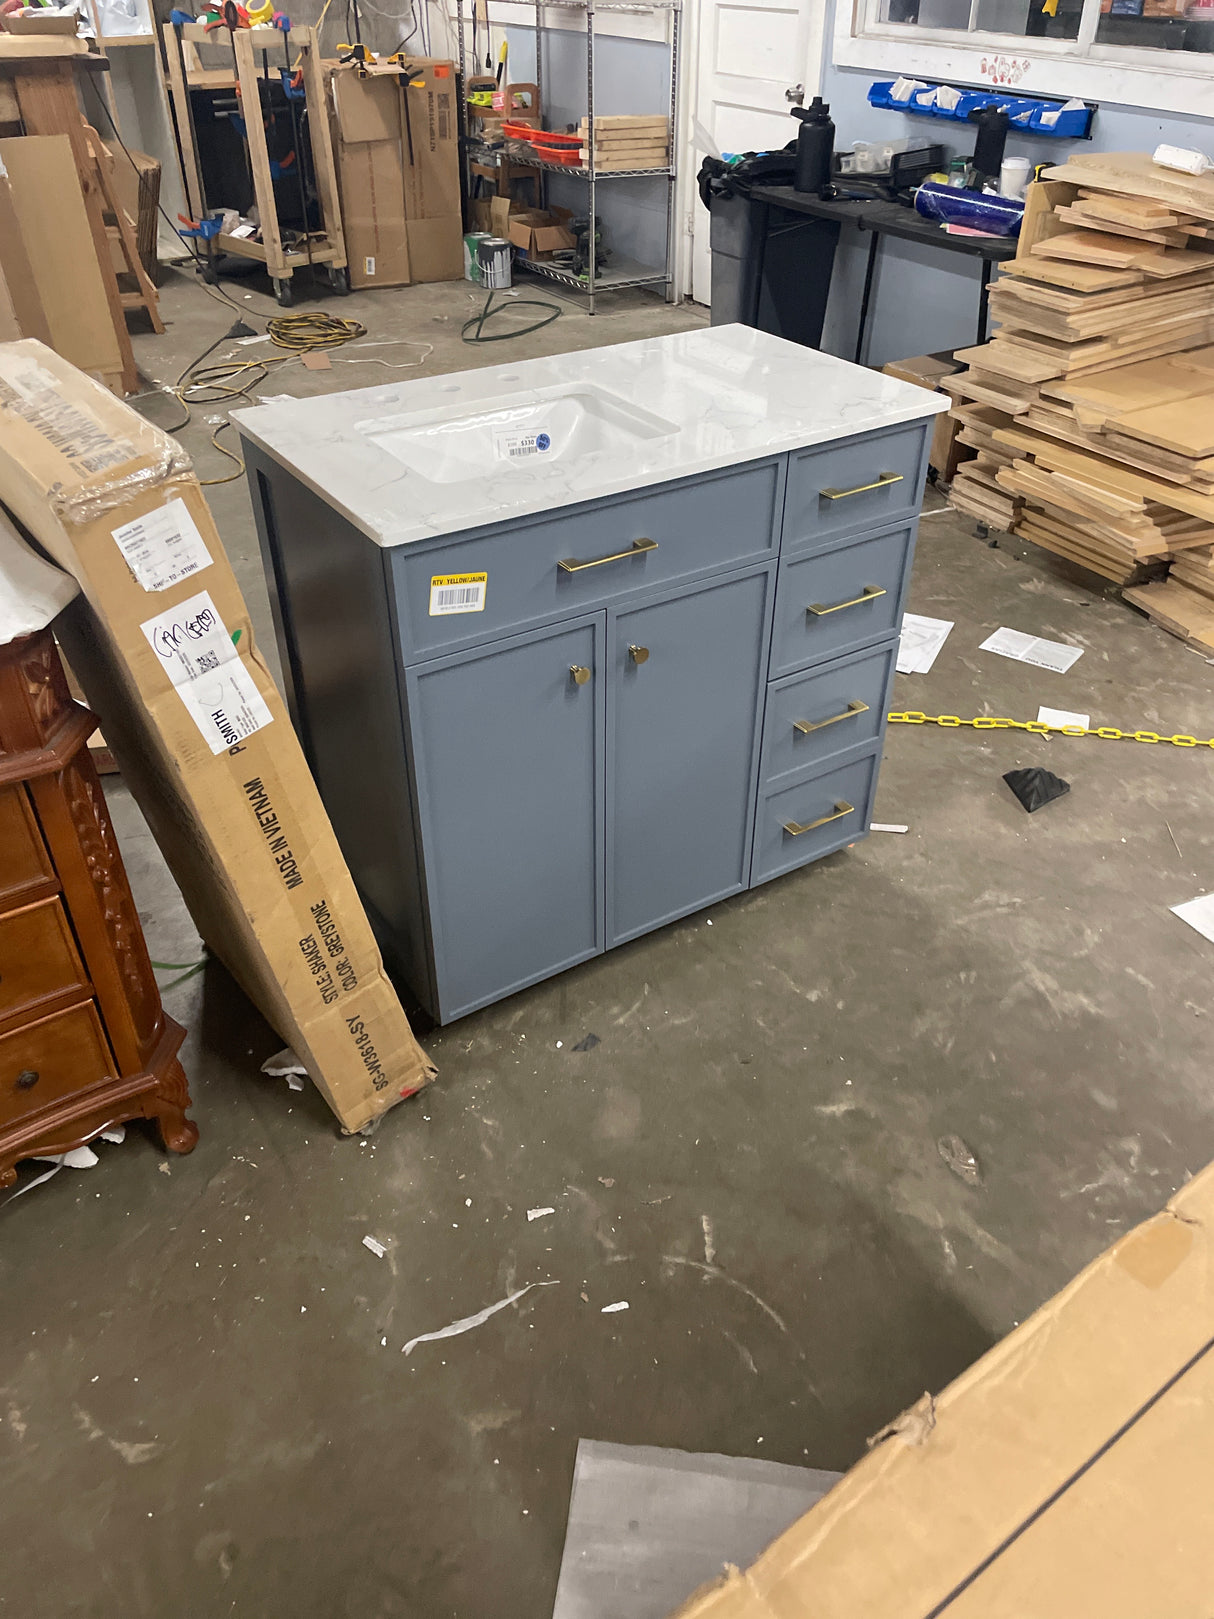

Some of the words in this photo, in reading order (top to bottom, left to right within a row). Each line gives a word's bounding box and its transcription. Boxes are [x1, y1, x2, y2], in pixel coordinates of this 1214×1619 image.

[210, 708, 238, 745] SMITH
[243, 777, 281, 840] VIETNAM
[268, 835, 289, 855] IN
[275, 850, 304, 890] MADE
[310, 899, 345, 958] GREYSTONE
[298, 933, 327, 975] SHAKER
[336, 956, 358, 992] COLOR:
[316, 970, 339, 1005] STYLE:
[345, 1014, 389, 1092] SG-W3618-SY
